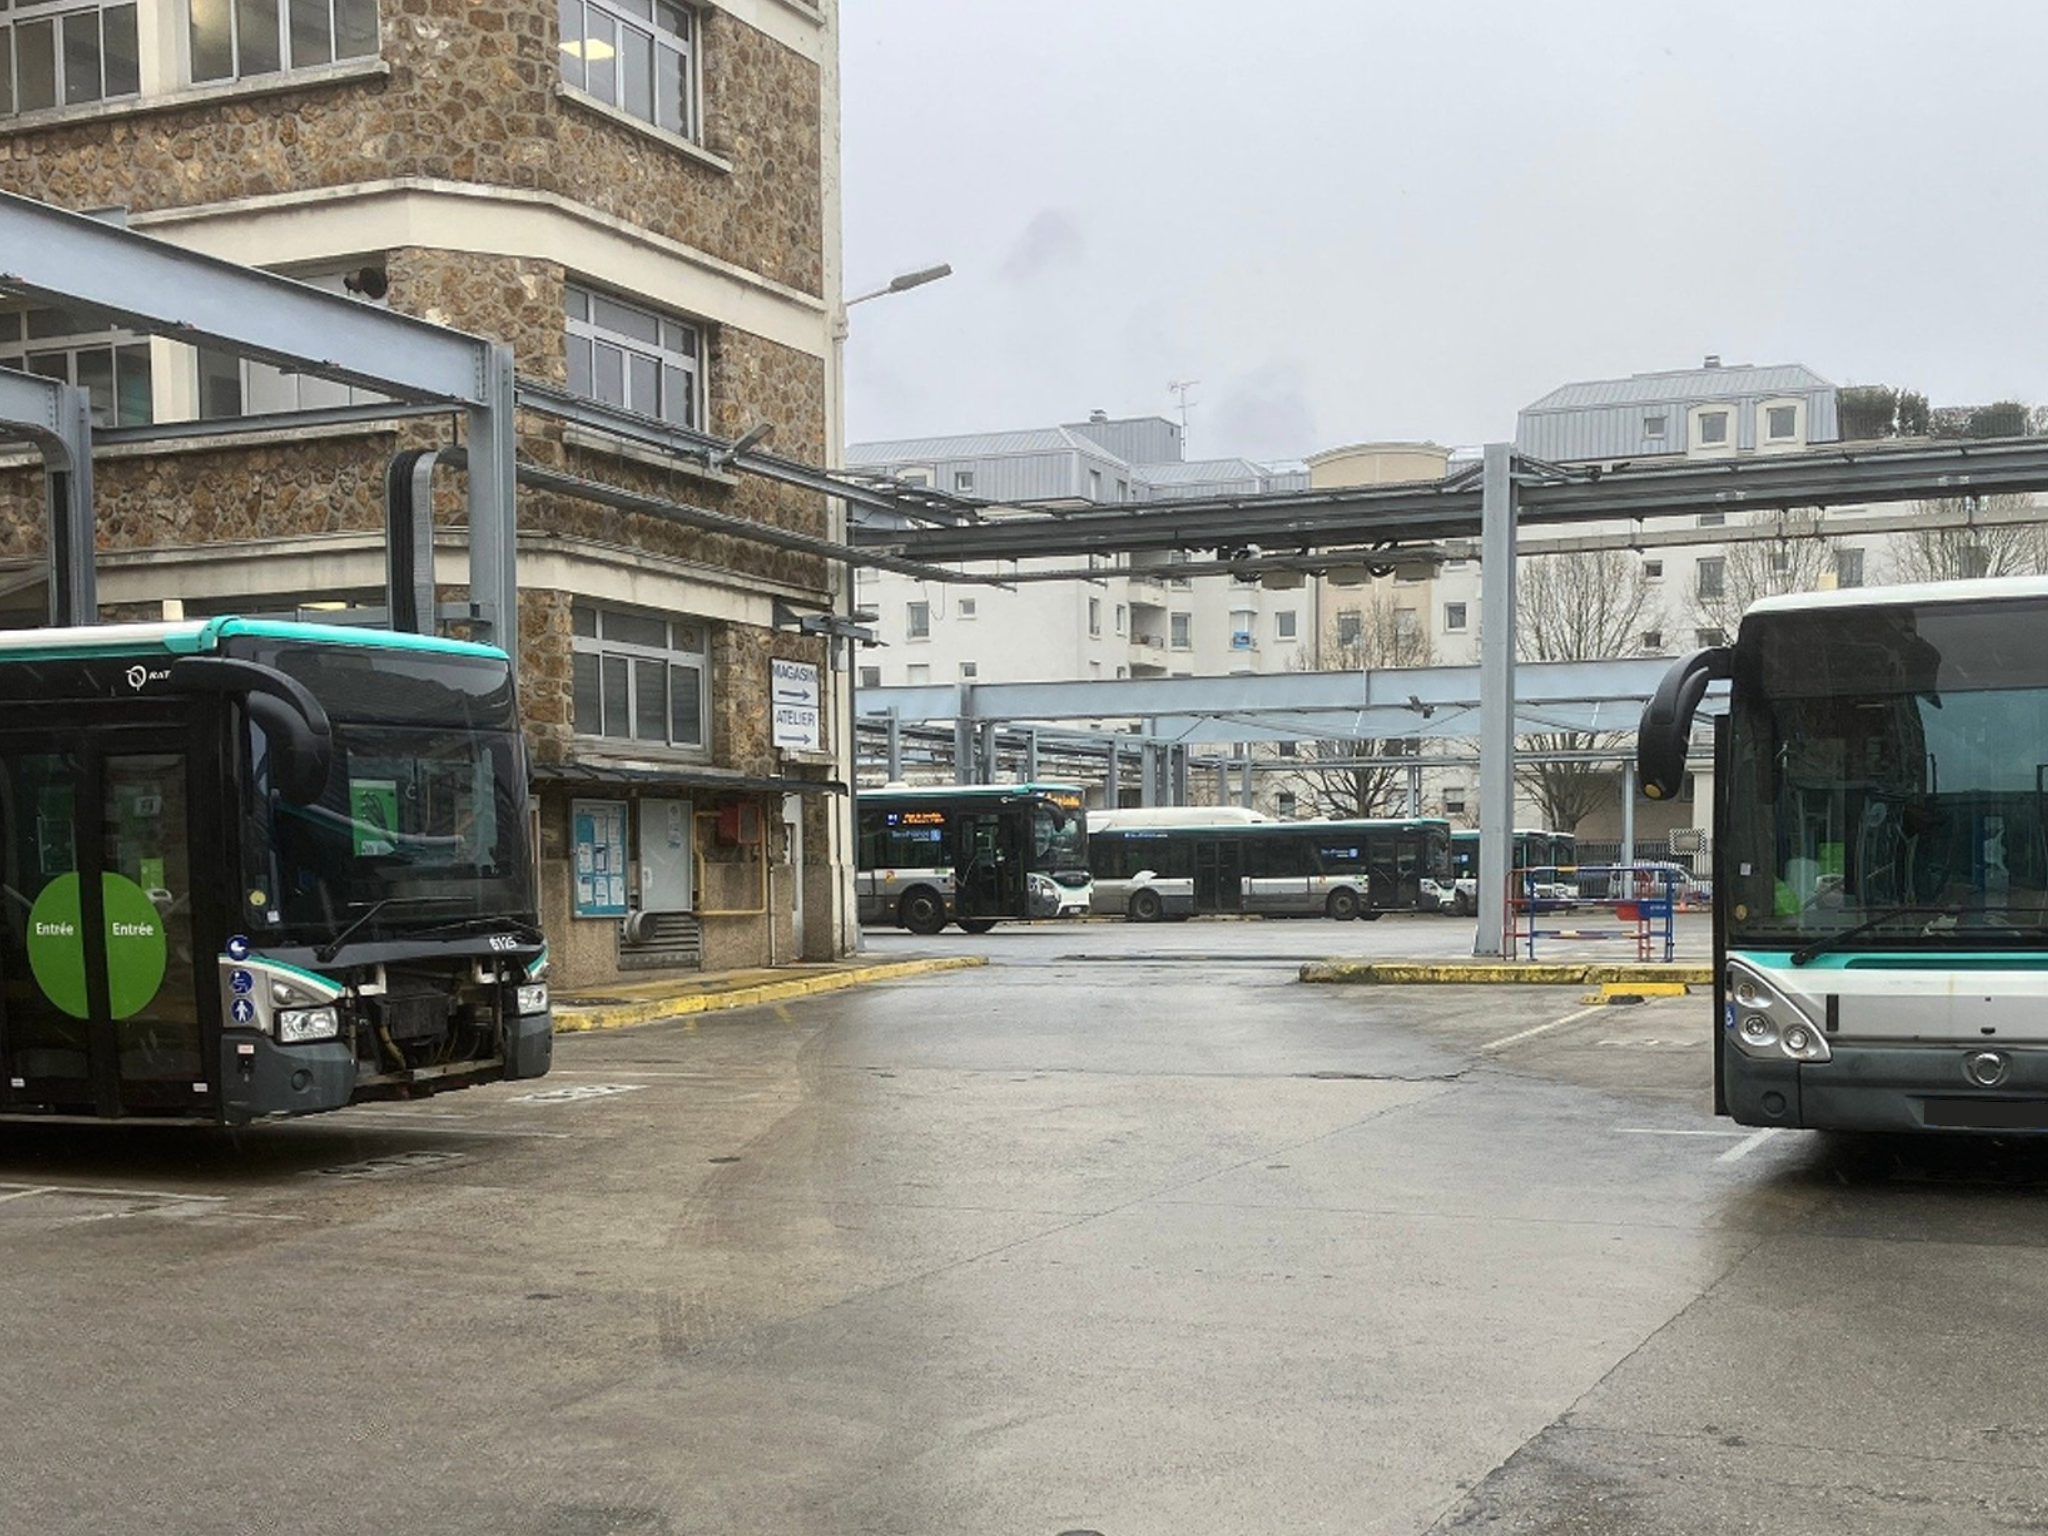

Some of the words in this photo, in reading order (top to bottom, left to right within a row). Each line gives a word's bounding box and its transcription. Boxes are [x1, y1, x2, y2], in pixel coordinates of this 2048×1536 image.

[148, 670, 172, 680] RAT
[776, 709, 816, 727] ATELIER
[35, 921, 75, 936] Entrée
[112, 921, 155, 936] Entrée
